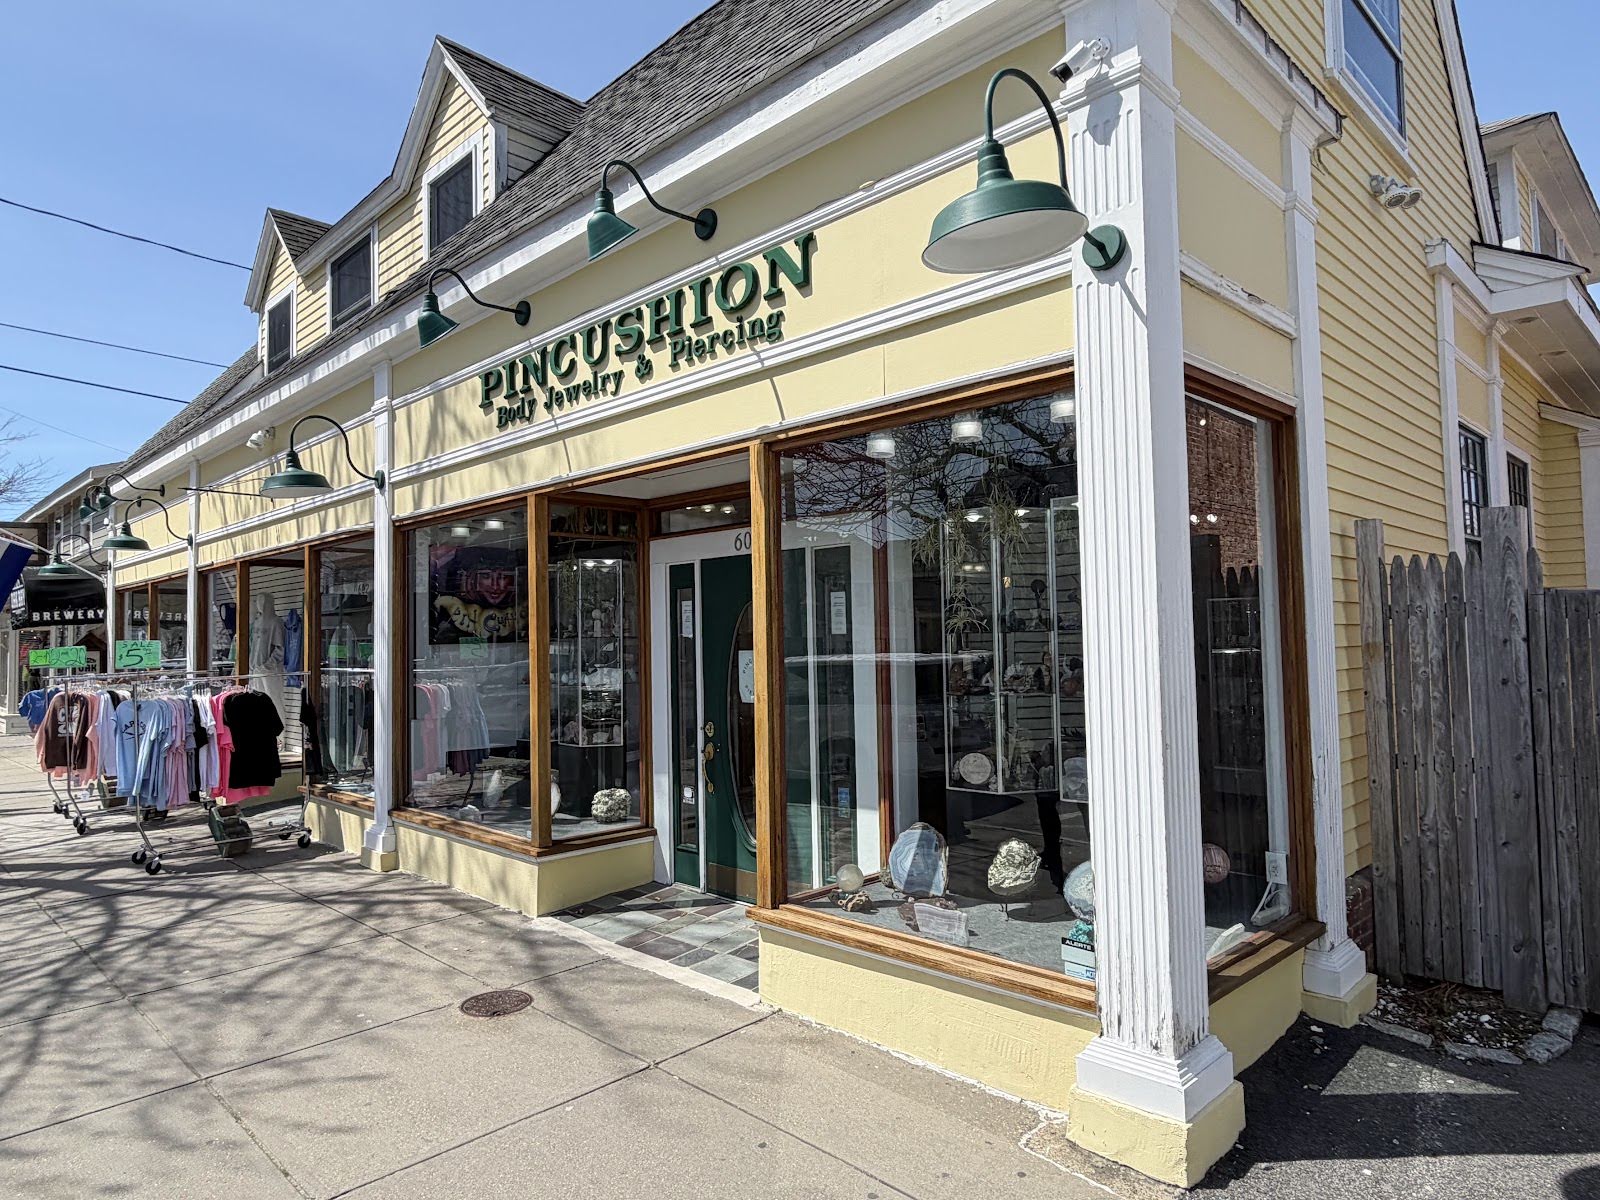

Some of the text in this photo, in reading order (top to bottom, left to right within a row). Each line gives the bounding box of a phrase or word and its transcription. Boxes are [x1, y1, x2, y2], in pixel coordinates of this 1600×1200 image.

[478, 231, 816, 409] PINCUSHION
[496, 310, 785, 429] Body Jewelry & Piercing
[32, 609, 105, 622] BREWERY
[121, 641, 154, 649] SALE
